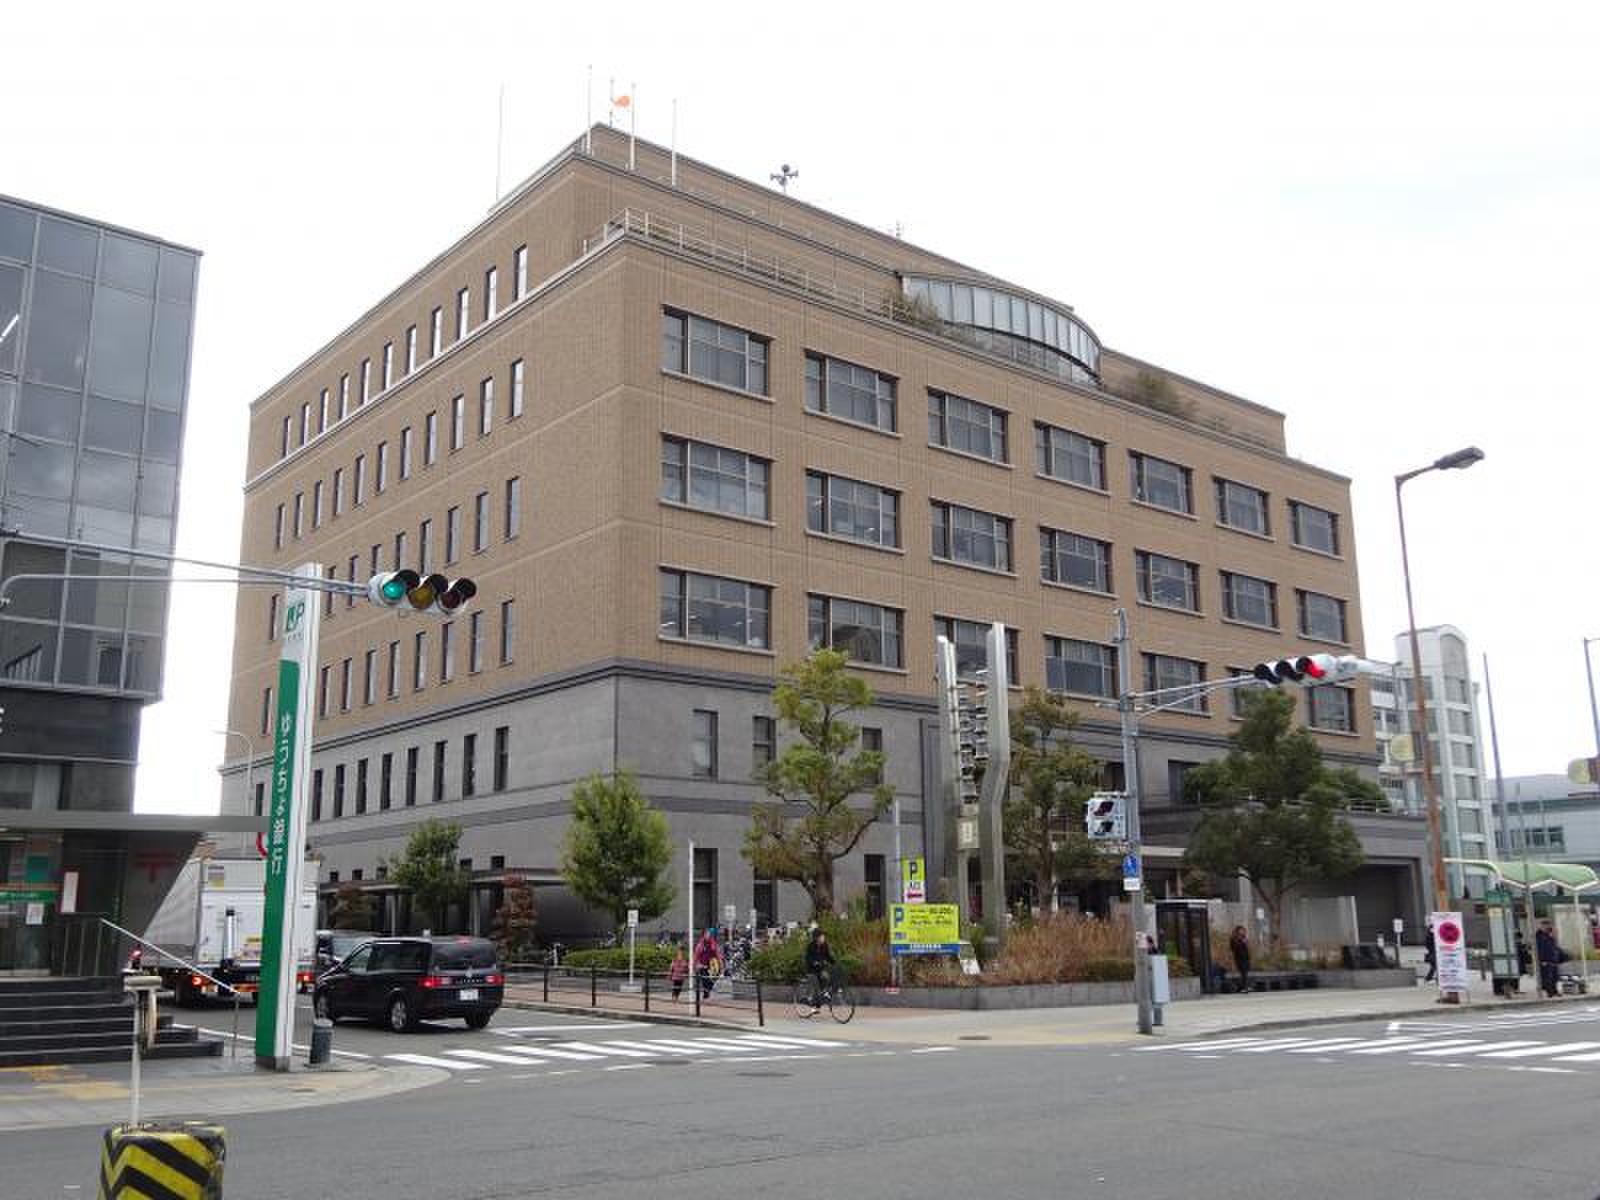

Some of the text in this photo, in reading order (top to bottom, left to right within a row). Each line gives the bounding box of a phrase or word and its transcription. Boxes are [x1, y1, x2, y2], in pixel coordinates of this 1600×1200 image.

[272, 713, 291, 875] ゆうちょ銀行
[909, 862, 918, 880] P
[895, 907, 904, 928] P
